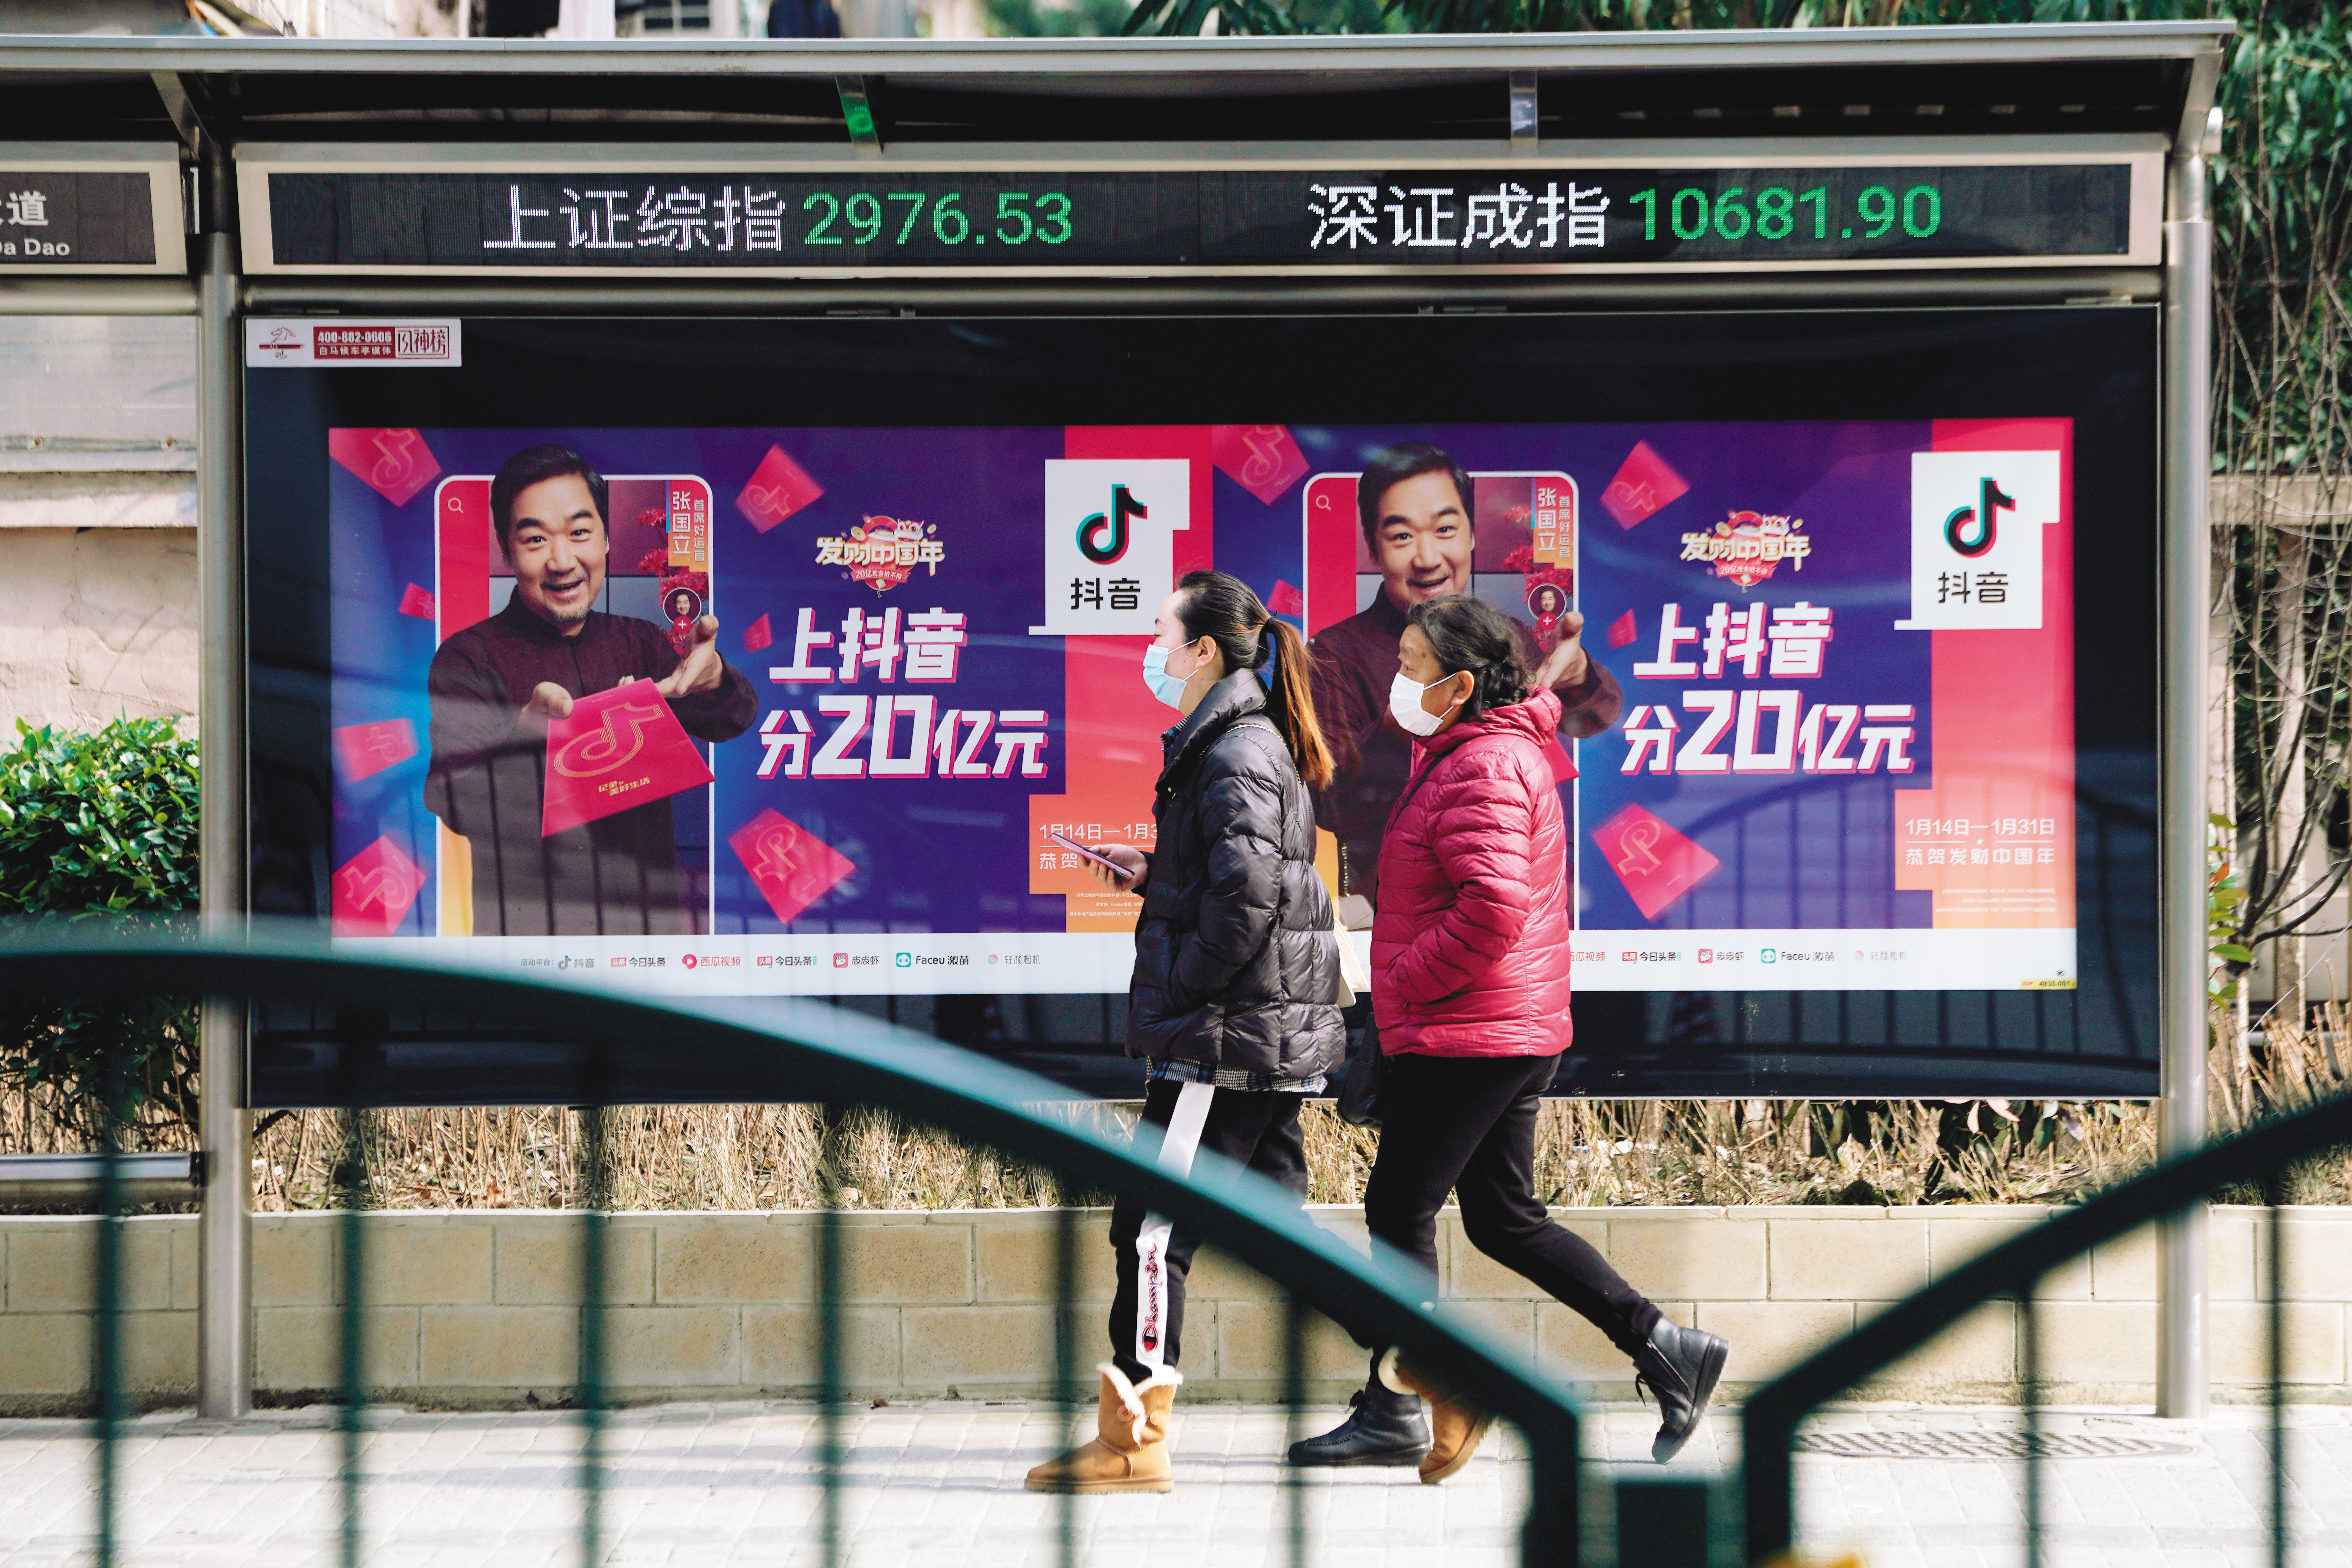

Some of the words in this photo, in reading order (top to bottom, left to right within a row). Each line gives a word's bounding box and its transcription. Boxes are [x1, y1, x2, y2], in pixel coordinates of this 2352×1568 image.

[0, 190, 49, 226] 道
[1309, 182, 1610, 249] 深证成指
[1630, 185, 1941, 241] 10681.90
[484, 185, 785, 251] 上证综指
[804, 192, 1073, 245] 2976.53
[0, 240, 16, 255] a
[24, 238, 70, 256] Dao
[318, 331, 392, 343] 400-882-0606
[319, 345, 392, 356] 白马候车亭媒体
[672, 490, 691, 555] 张国立
[1538, 487, 1556, 551] 张国立
[1559, 496, 1570, 558] 首席好运官
[694, 499, 705, 562] 首席好运官
[815, 537, 945, 577] 发财中国年
[1679, 532, 1811, 572] 发财中国年
[1071, 578, 1141, 610] 抖音
[1938, 572, 2009, 604] 抖音
[769, 607, 967, 683] 上抖音
[1633, 601, 1833, 679] 上抖音
[757, 695, 1048, 780] 分20亿元
[1620, 690, 1915, 775] 分20亿元
[1040, 853, 1078, 869] 恭贺
[1905, 848, 2055, 865] 恭贺发财中国年
[574, 958, 595, 968] 抖音
[629, 957, 665, 967] 今日头条
[700, 956, 741, 967] 西瓜视频
[775, 956, 812, 965] 今日头条
[852, 956, 879, 965] 皮皮虾
[916, 956, 945, 965] Faceu
[947, 956, 969, 965] 激萌
[1004, 955, 1041, 965] 轻颜相机
[1639, 952, 1676, 961] 今日头条
[1716, 951, 1744, 961] 皮皮虾
[1781, 951, 1810, 960] Faceu
[1870, 951, 1907, 961] 轻颜相机
